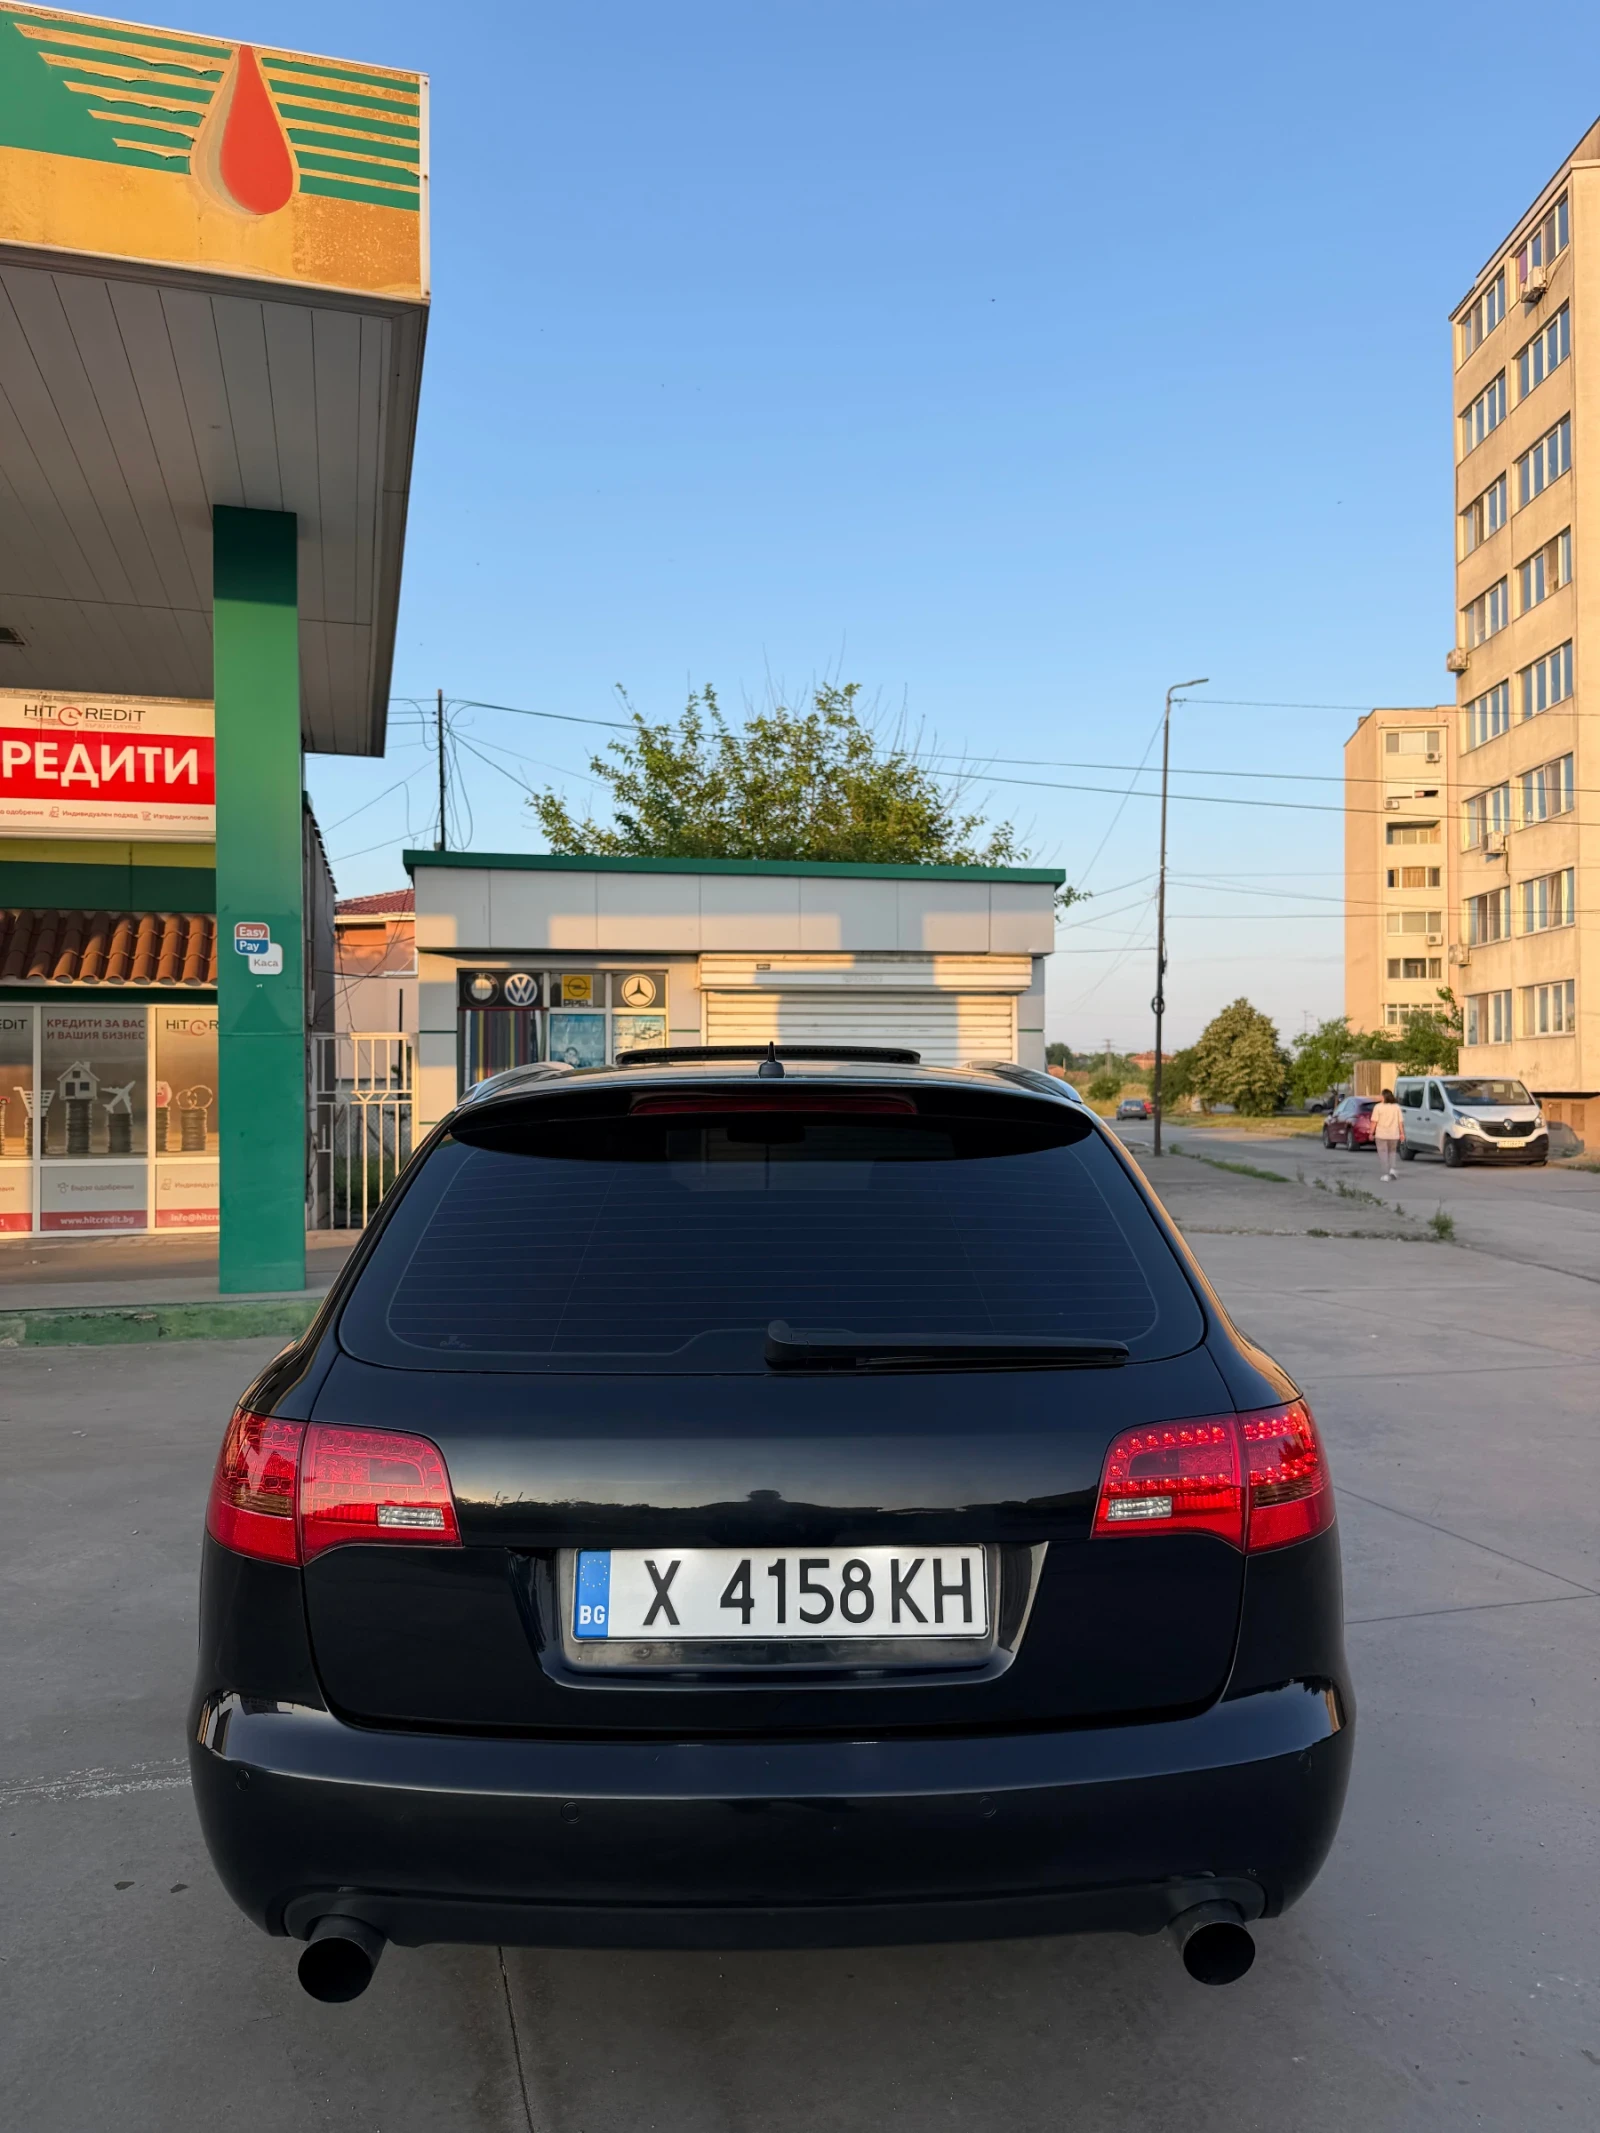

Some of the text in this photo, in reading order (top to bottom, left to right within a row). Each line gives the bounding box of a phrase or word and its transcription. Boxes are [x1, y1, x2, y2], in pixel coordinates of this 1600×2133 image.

[6, 808, 44, 816] одобрение
[239, 926, 265, 939] Easy
[239, 940, 259, 952] Pay
[254, 958, 279, 967] Каса
[46, 1018, 145, 1029] КРЕДИТИ ЗА ВАС
[46, 1031, 145, 1040] И ВАШИЯ БИЗНЕС
[71, 1183, 134, 1192] Бързо одобрение
[60, 1215, 135, 1225] www.hitcredit.bg
[579, 1605, 605, 1625] BG
